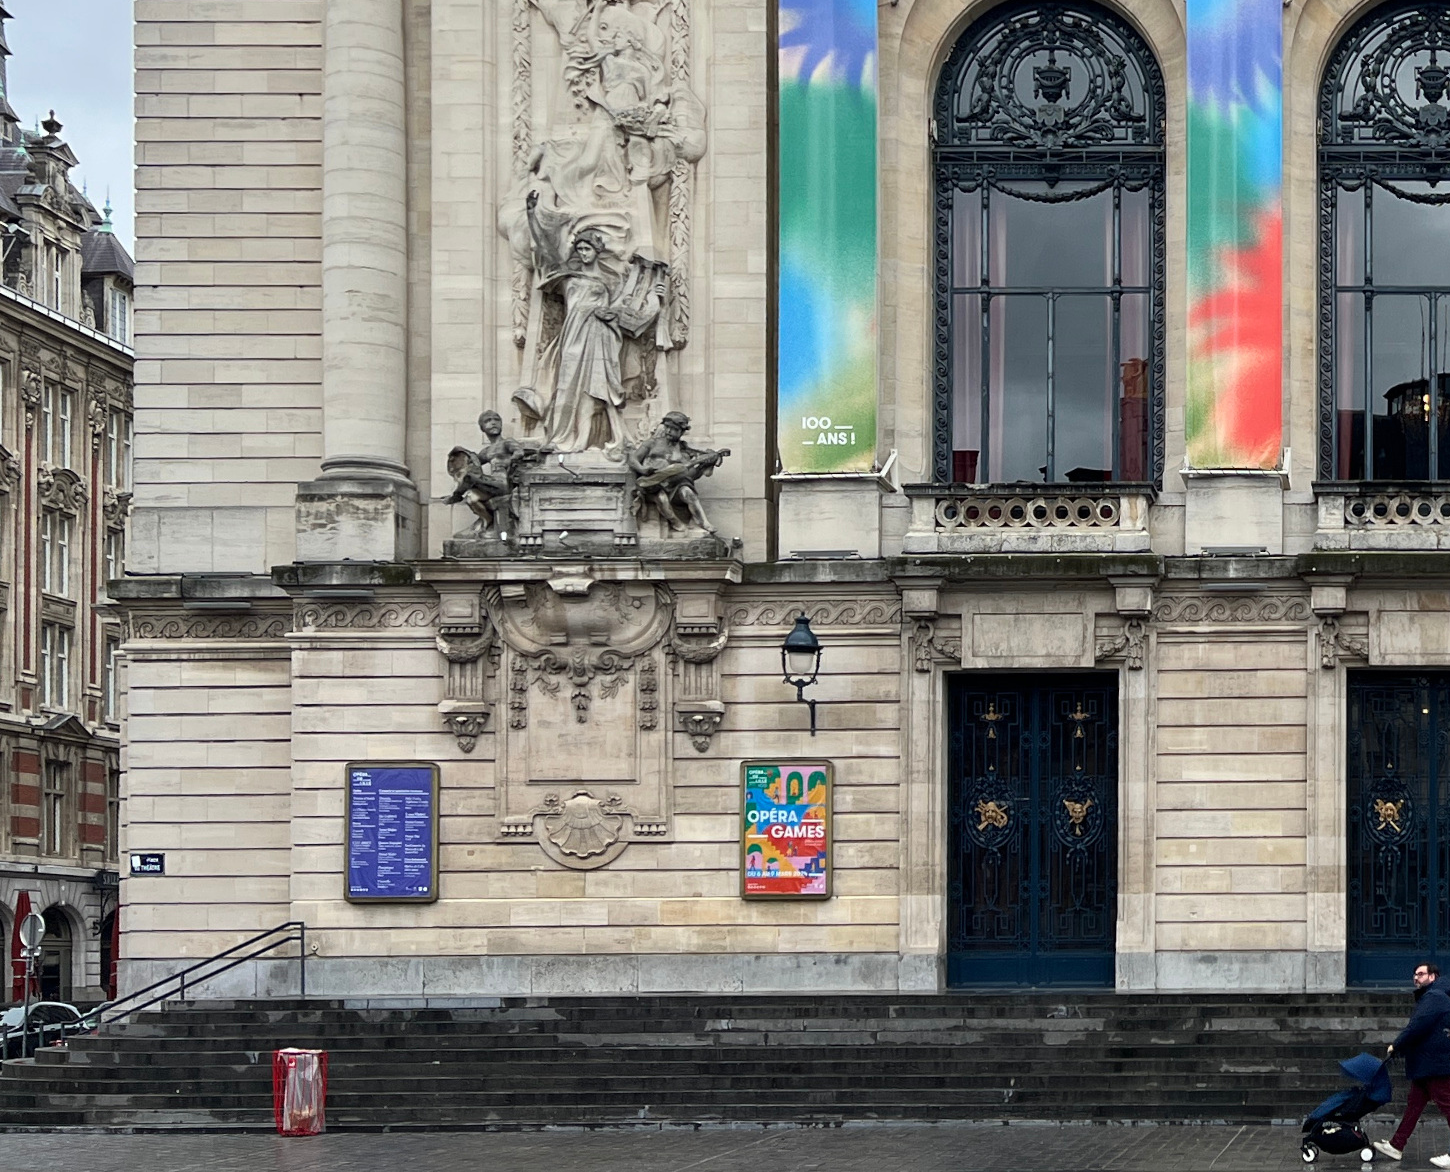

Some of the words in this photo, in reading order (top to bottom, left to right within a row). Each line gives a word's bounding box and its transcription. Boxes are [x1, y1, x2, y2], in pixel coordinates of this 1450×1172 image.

[802, 417, 831, 430] 100
[748, 808, 798, 822] OPÉRA
[771, 826, 824, 838] GAMES
